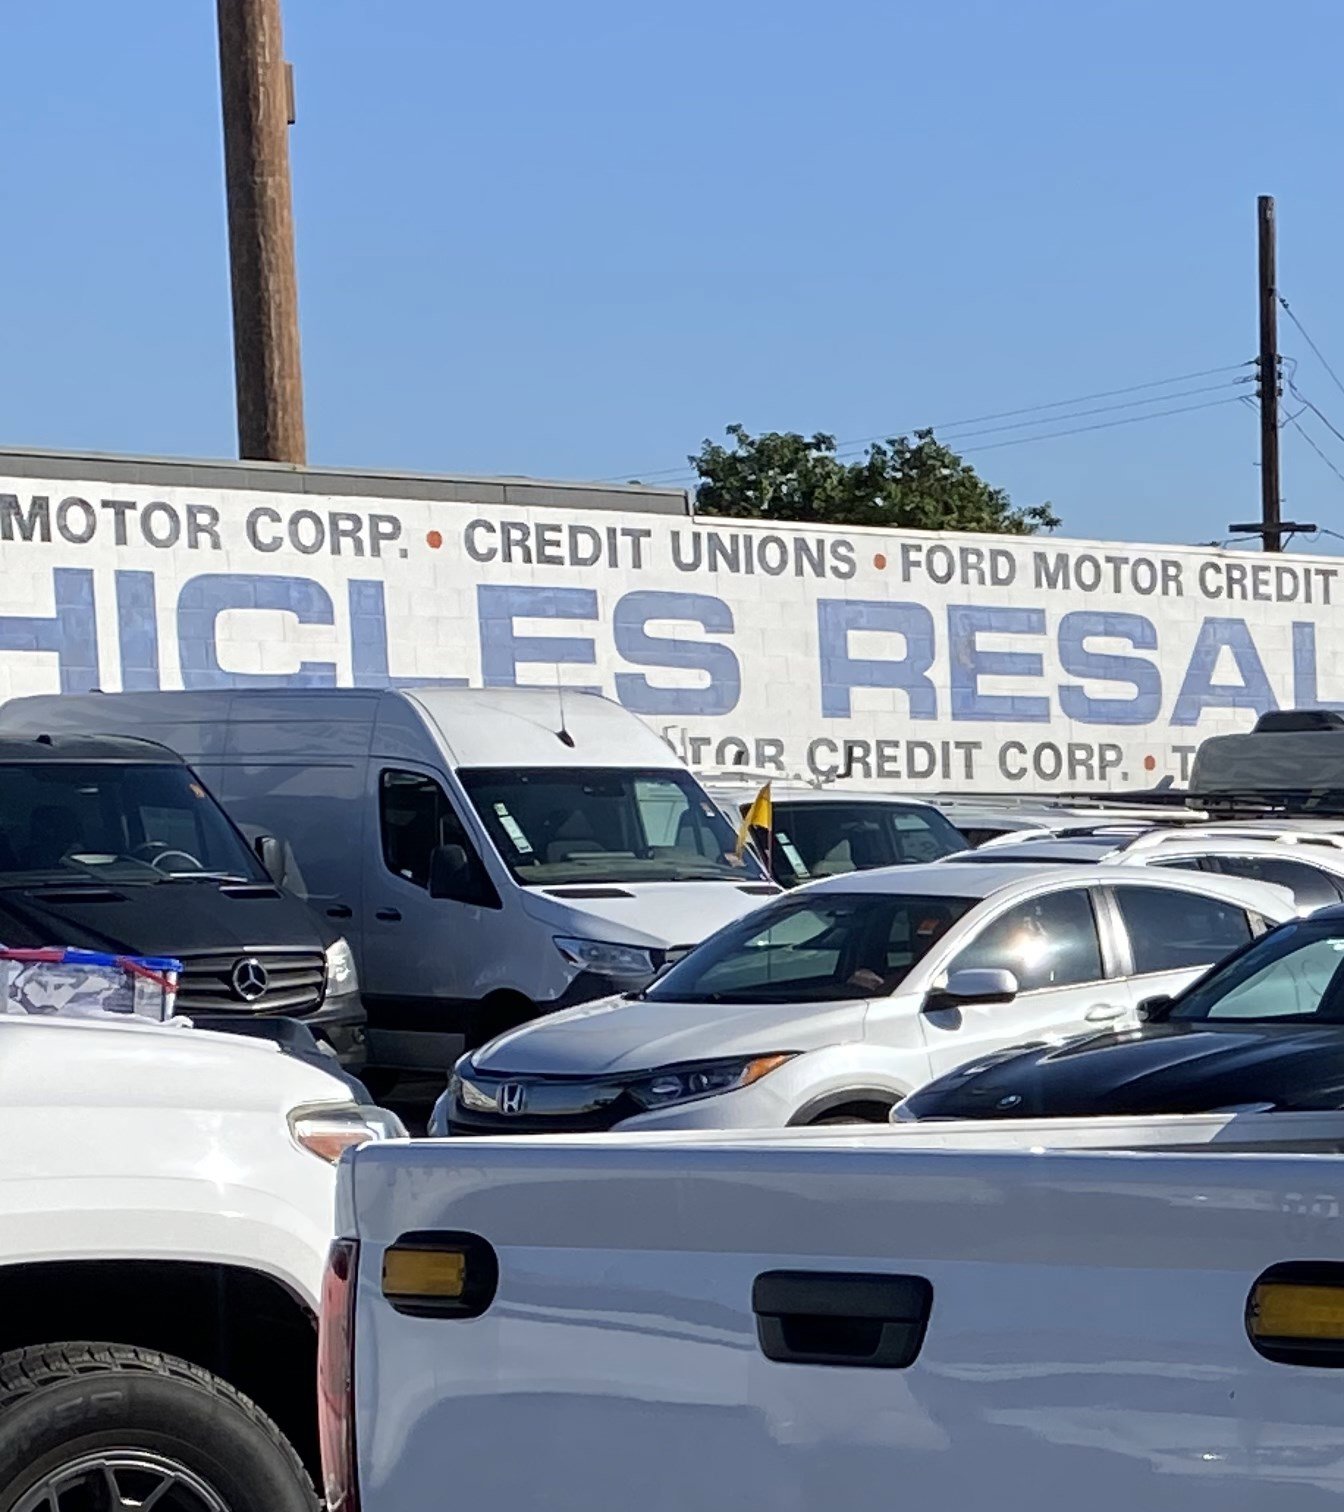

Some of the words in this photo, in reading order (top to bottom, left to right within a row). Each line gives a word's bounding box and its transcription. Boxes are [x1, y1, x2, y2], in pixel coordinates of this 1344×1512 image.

[0, 494, 221, 550] MOTOR
[246, 506, 408, 559] CORP.
[464, 519, 652, 570] CREDIT
[671, 529, 857, 579] UNIONS
[901, 543, 1016, 587] FORD
[1034, 552, 1184, 598] MOTOR
[1199, 562, 1338, 605] CREDIT
[807, 736, 982, 781] CREDIT
[1001, 738, 1129, 782] CORP.
